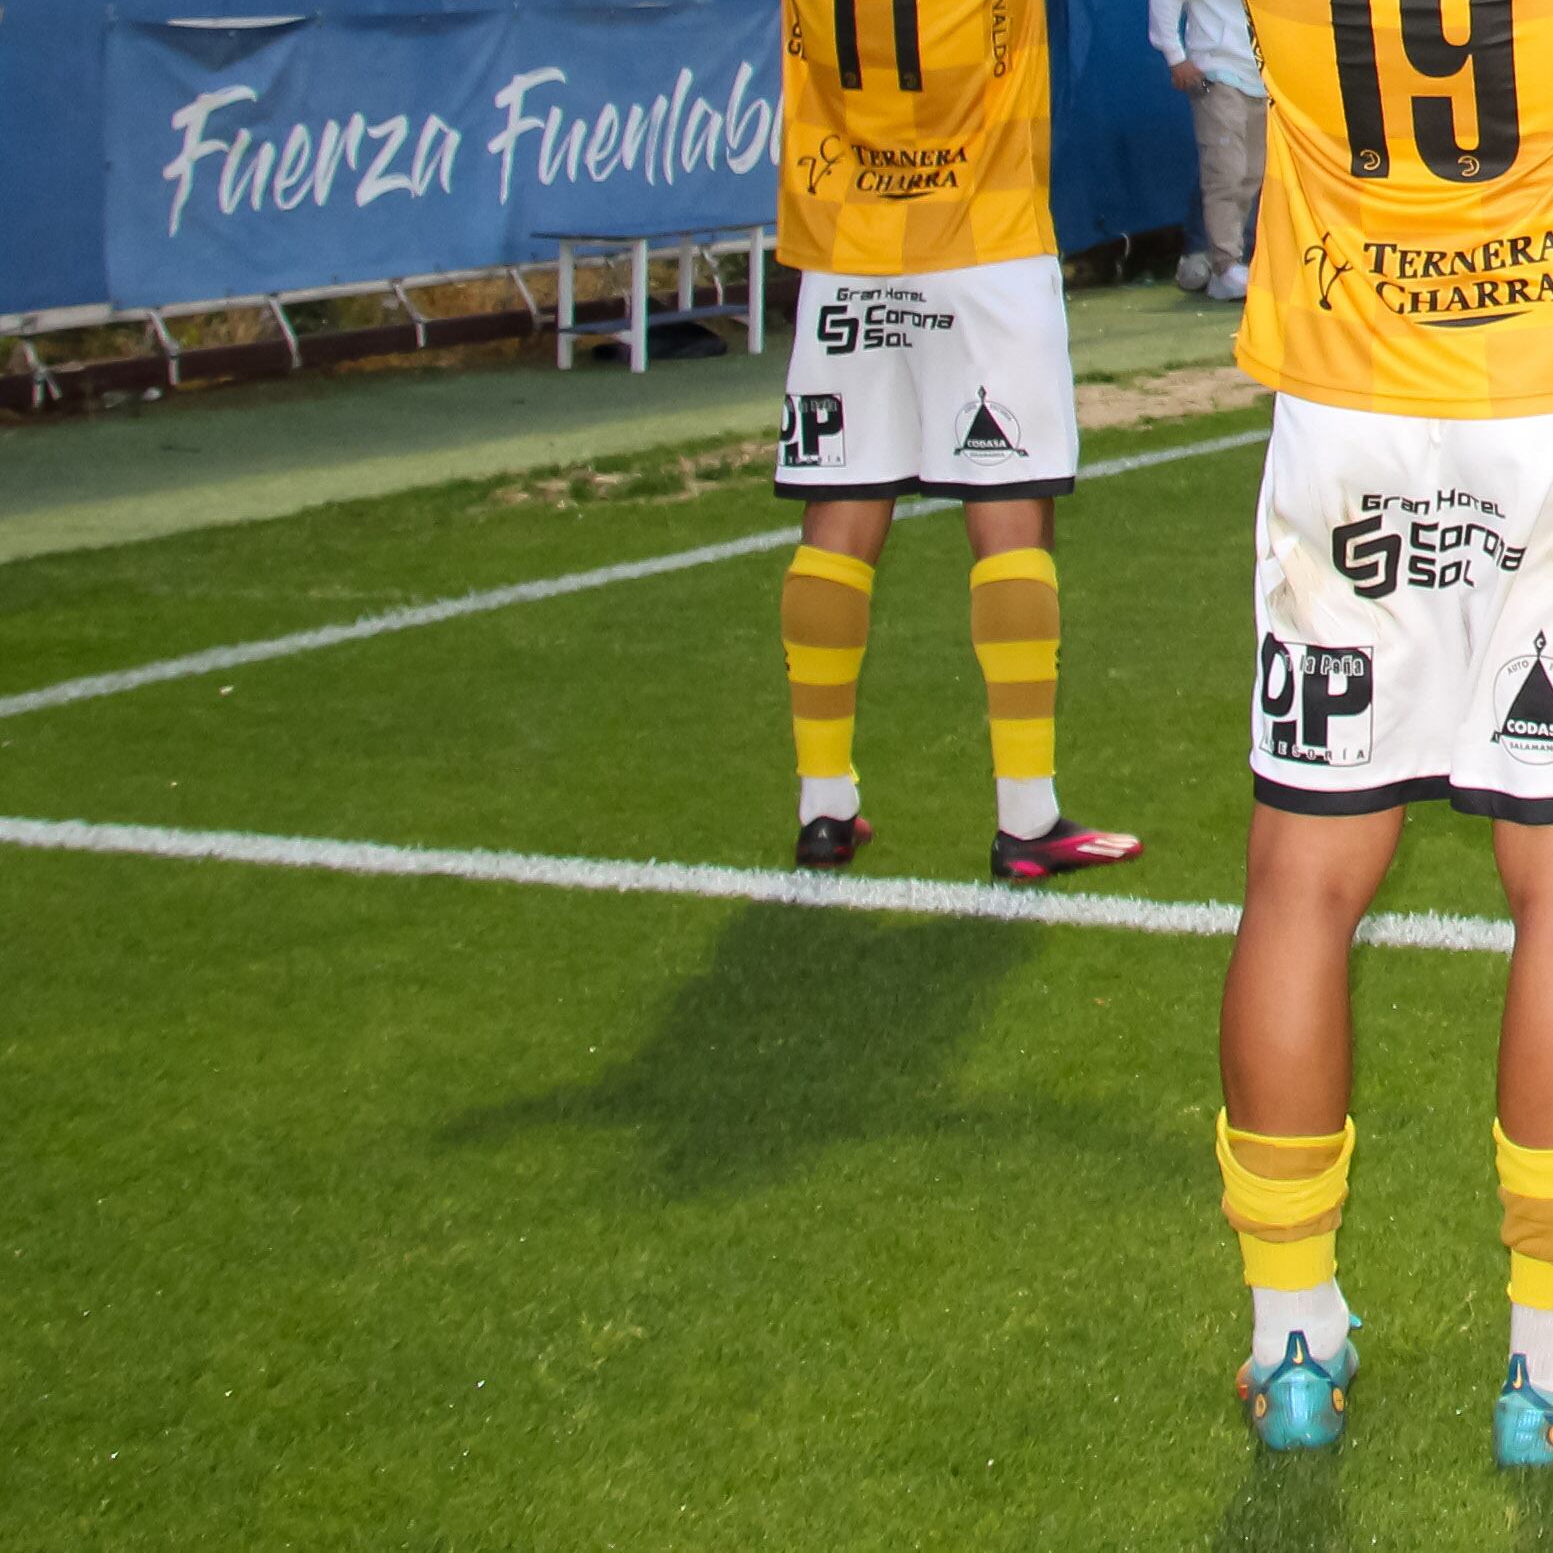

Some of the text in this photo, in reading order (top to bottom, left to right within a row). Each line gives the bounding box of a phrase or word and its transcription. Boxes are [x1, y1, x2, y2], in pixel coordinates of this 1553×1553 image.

[163, 84, 463, 238] Fuerza
[836, 287, 882, 302] Gran
[864, 304, 955, 330] Corona
[1361, 493, 1431, 515] Gran
[1409, 520, 1528, 572] Corona
